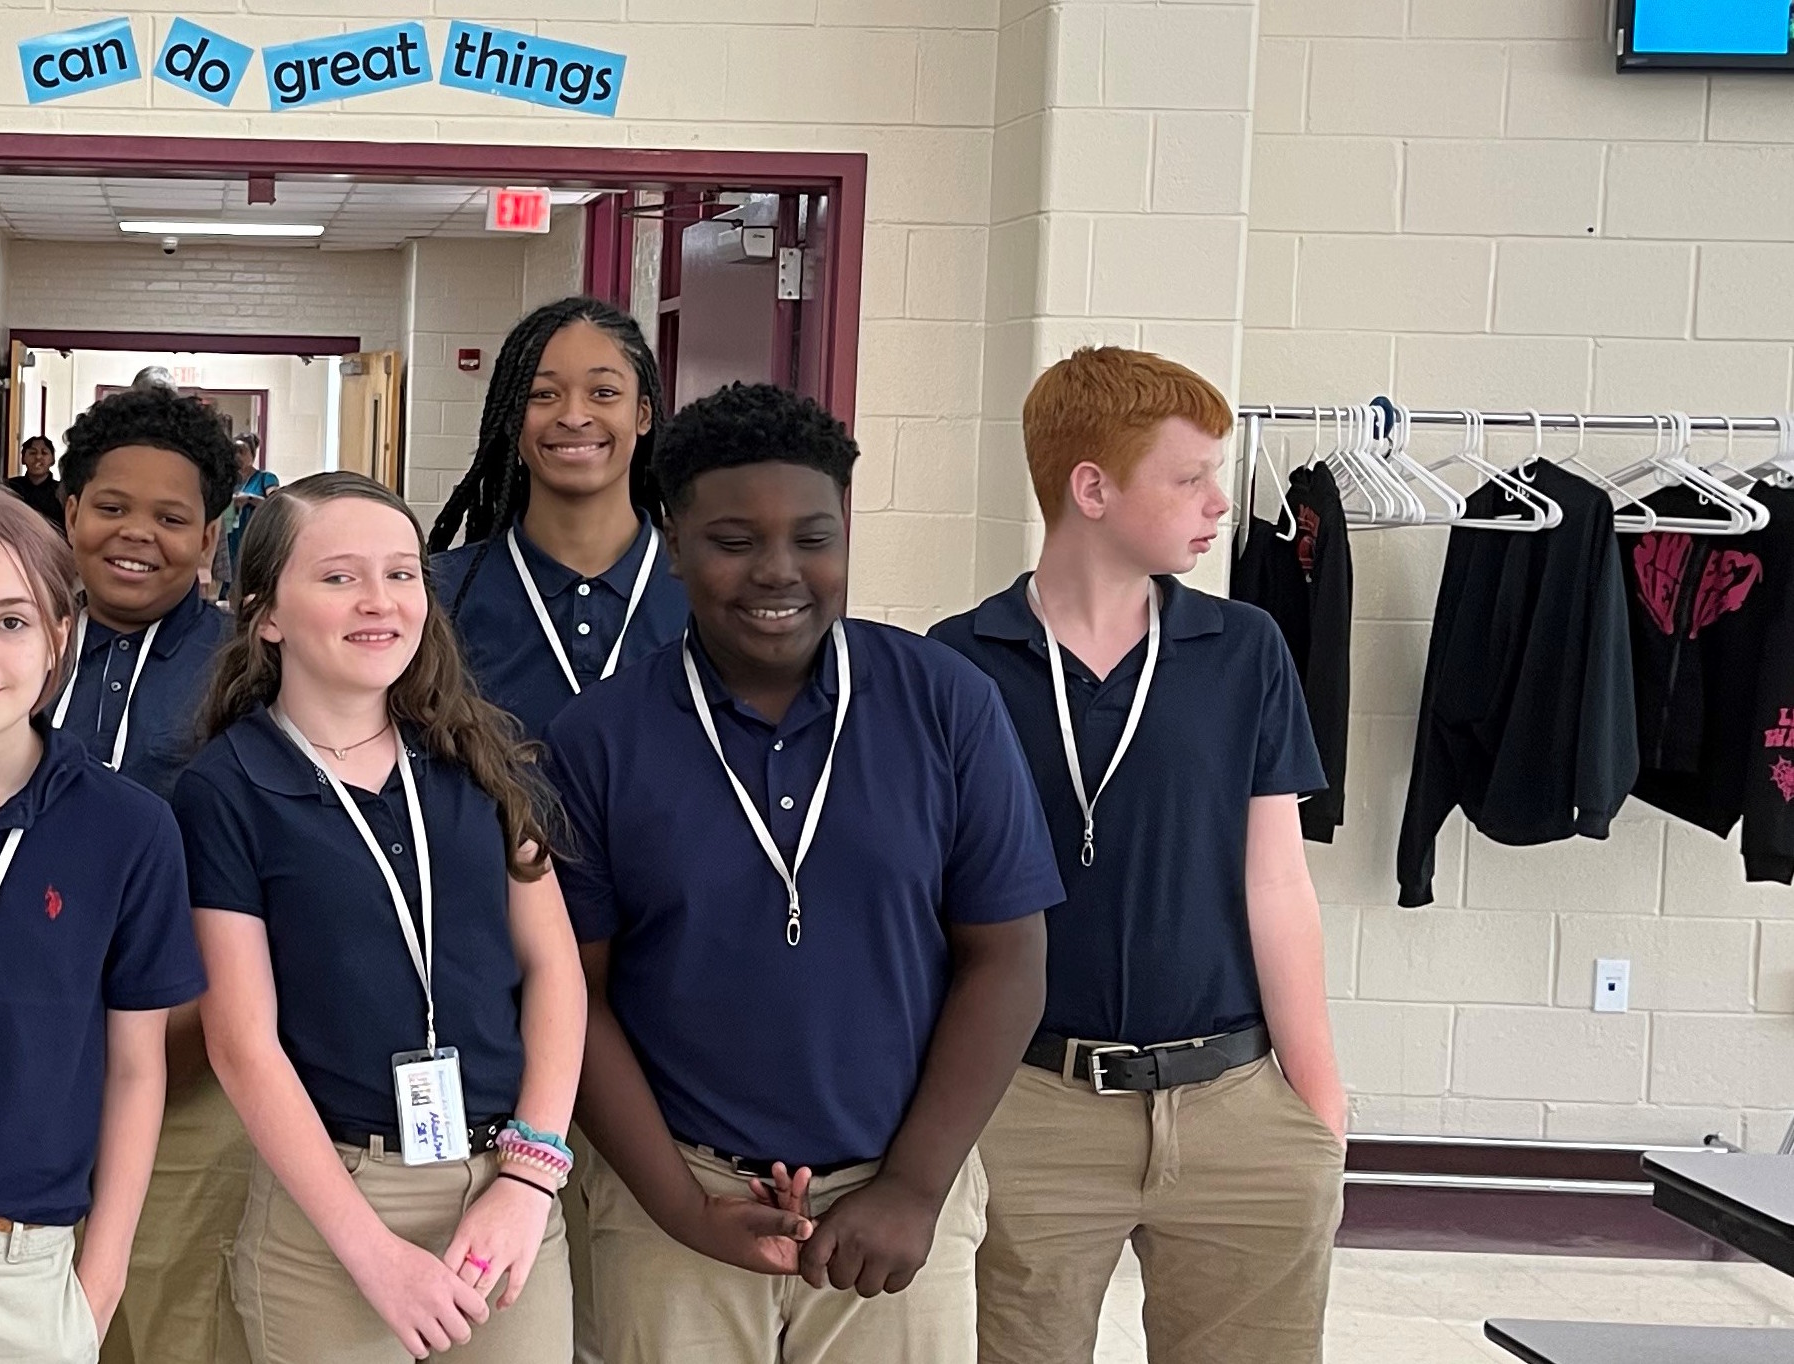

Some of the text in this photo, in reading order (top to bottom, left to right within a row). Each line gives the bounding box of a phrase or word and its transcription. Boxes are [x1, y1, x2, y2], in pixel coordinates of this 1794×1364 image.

[33, 31, 612, 105] can do great things
[496, 193, 544, 227] EXIT
